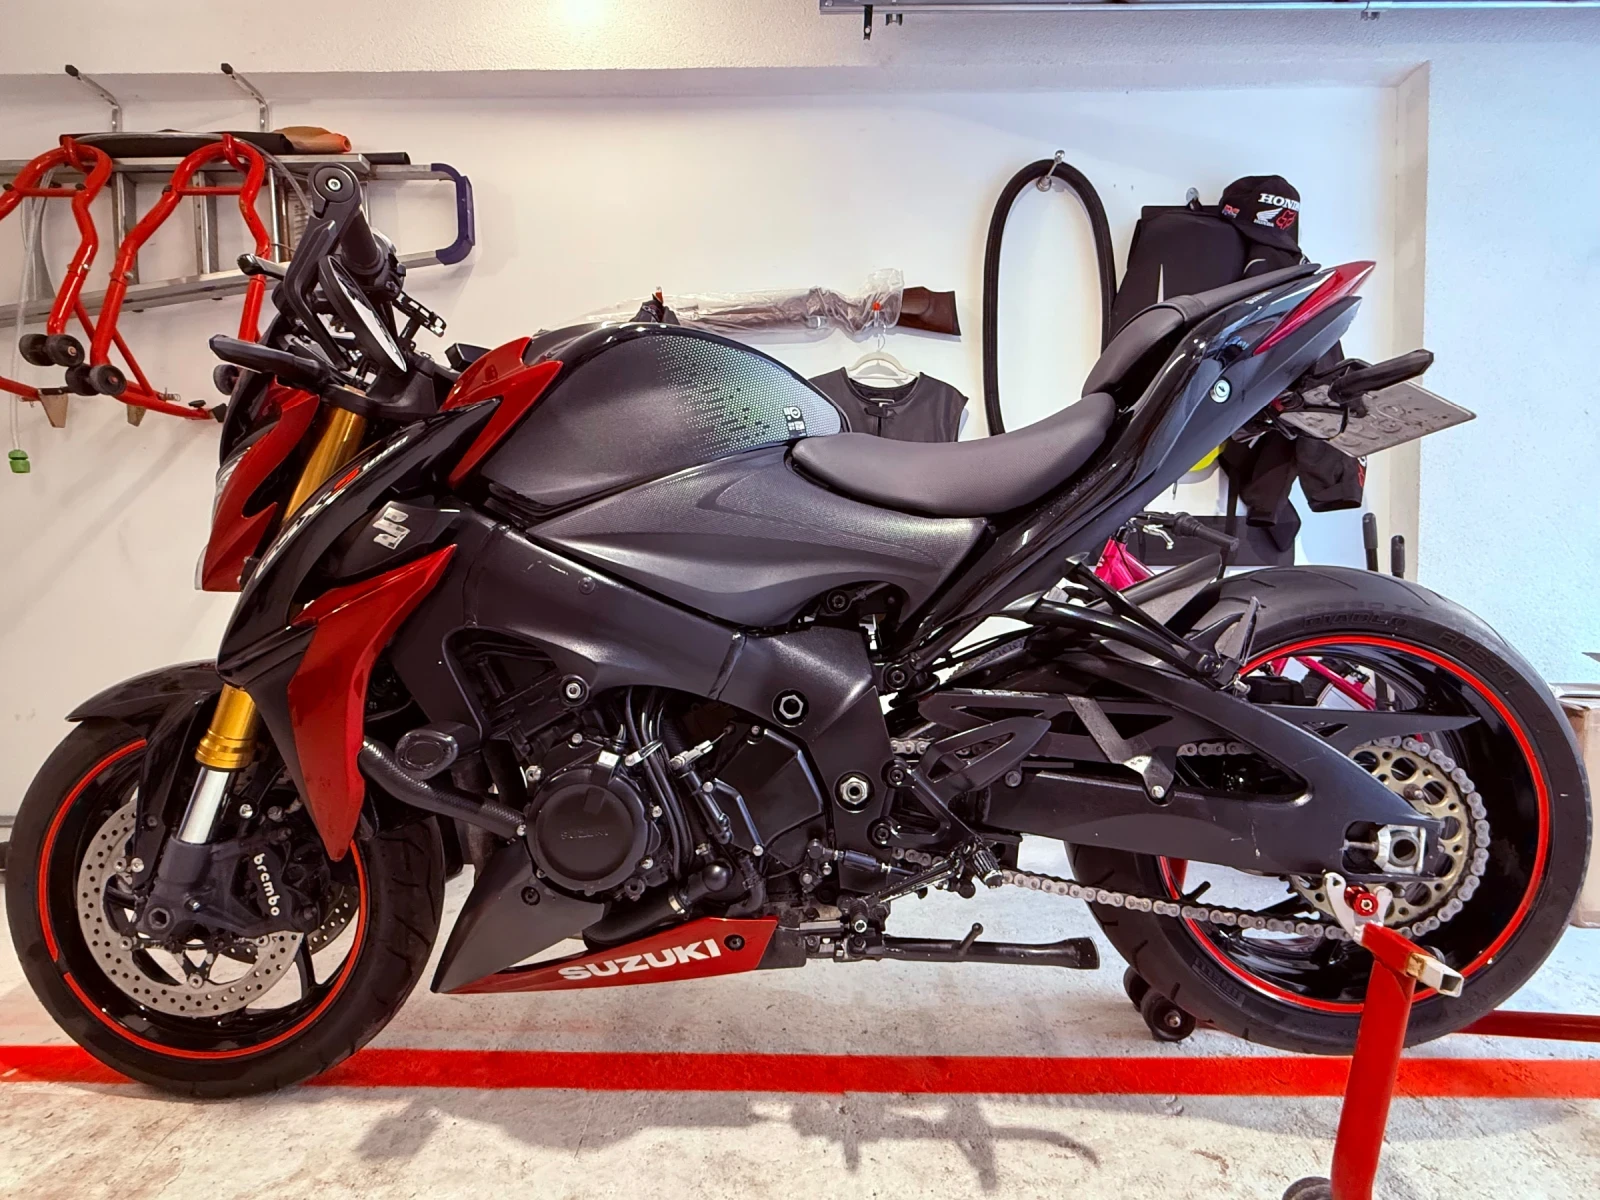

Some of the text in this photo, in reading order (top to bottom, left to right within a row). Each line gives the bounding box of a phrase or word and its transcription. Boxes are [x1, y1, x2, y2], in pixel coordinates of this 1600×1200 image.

[1438, 630, 1517, 685] ROSSO
[253, 852, 281, 917] brembo
[557, 938, 722, 981] SUZUKI
